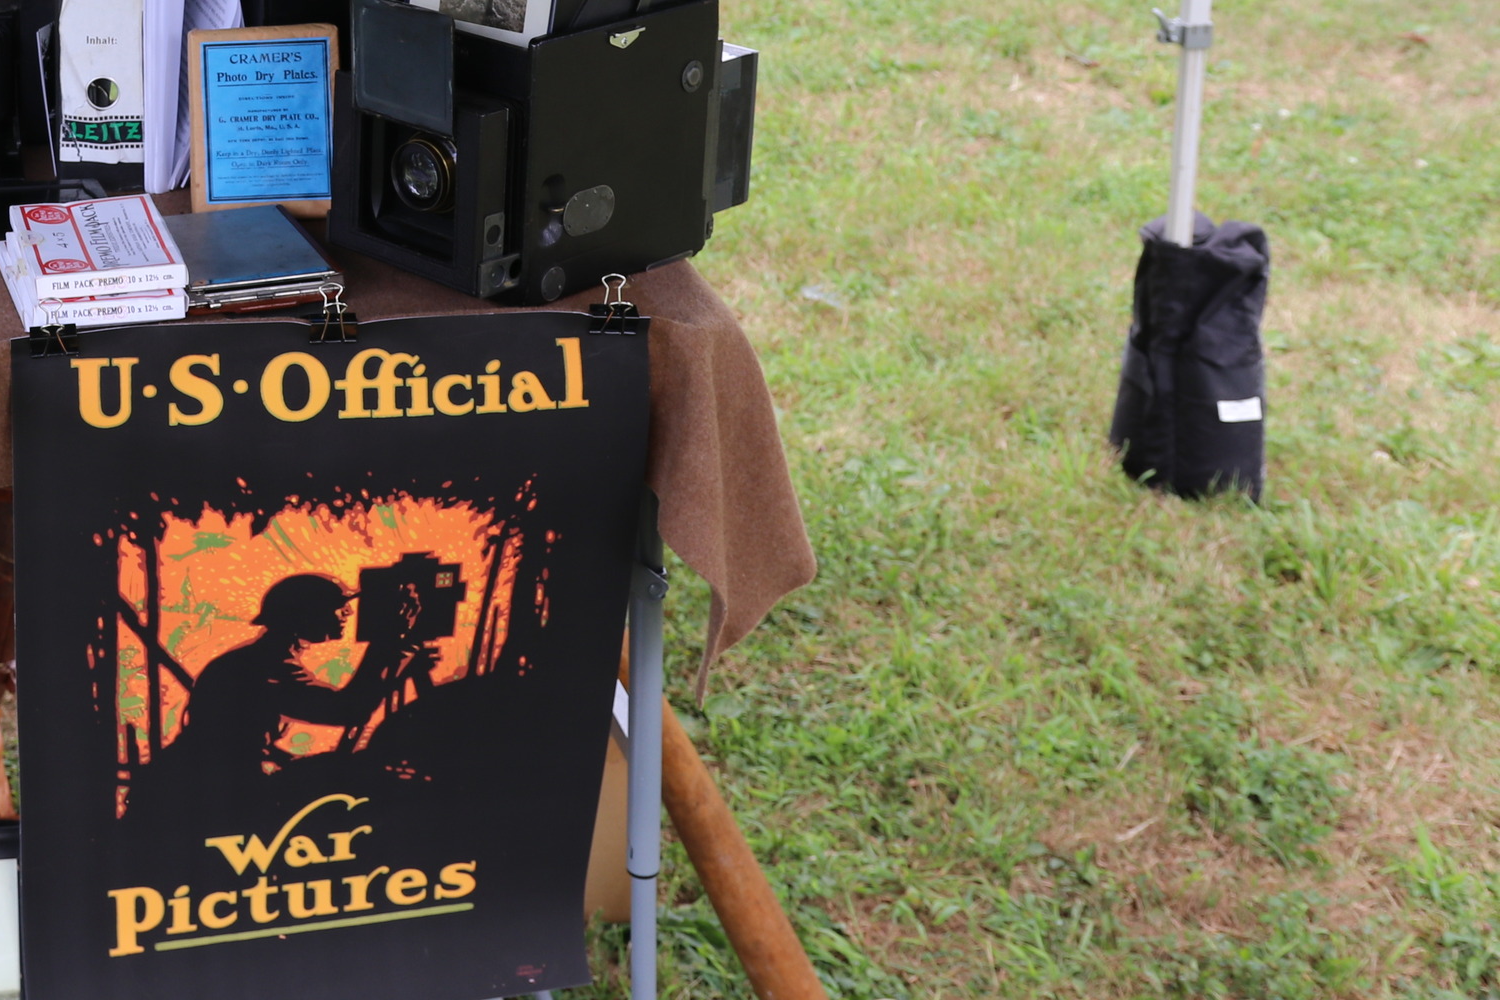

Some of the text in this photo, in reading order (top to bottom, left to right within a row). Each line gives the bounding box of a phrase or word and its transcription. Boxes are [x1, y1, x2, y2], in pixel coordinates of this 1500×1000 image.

[86, 36, 117, 45] Inhalt:
[229, 51, 302, 65] CRAMER'S
[217, 69, 318, 83] Photo Dry Plates.
[230, 115, 258, 123] CRAMER
[262, 114, 276, 122] DRY
[280, 113, 301, 121] PLATE
[68, 121, 141, 141] LEITZ
[79, 203, 109, 227] PACK
[52, 281, 70, 290] FILM
[74, 279, 94, 288] PACK
[98, 276, 124, 286] PREMO
[128, 275, 136, 284] 10
[51, 310, 69, 319] FLM
[73, 308, 92, 318] PACK
[97, 306, 123, 316] PREMO
[127, 305, 135, 314] 10
[204, 793, 373, 876] War
[107, 859, 477, 957] Pictures
